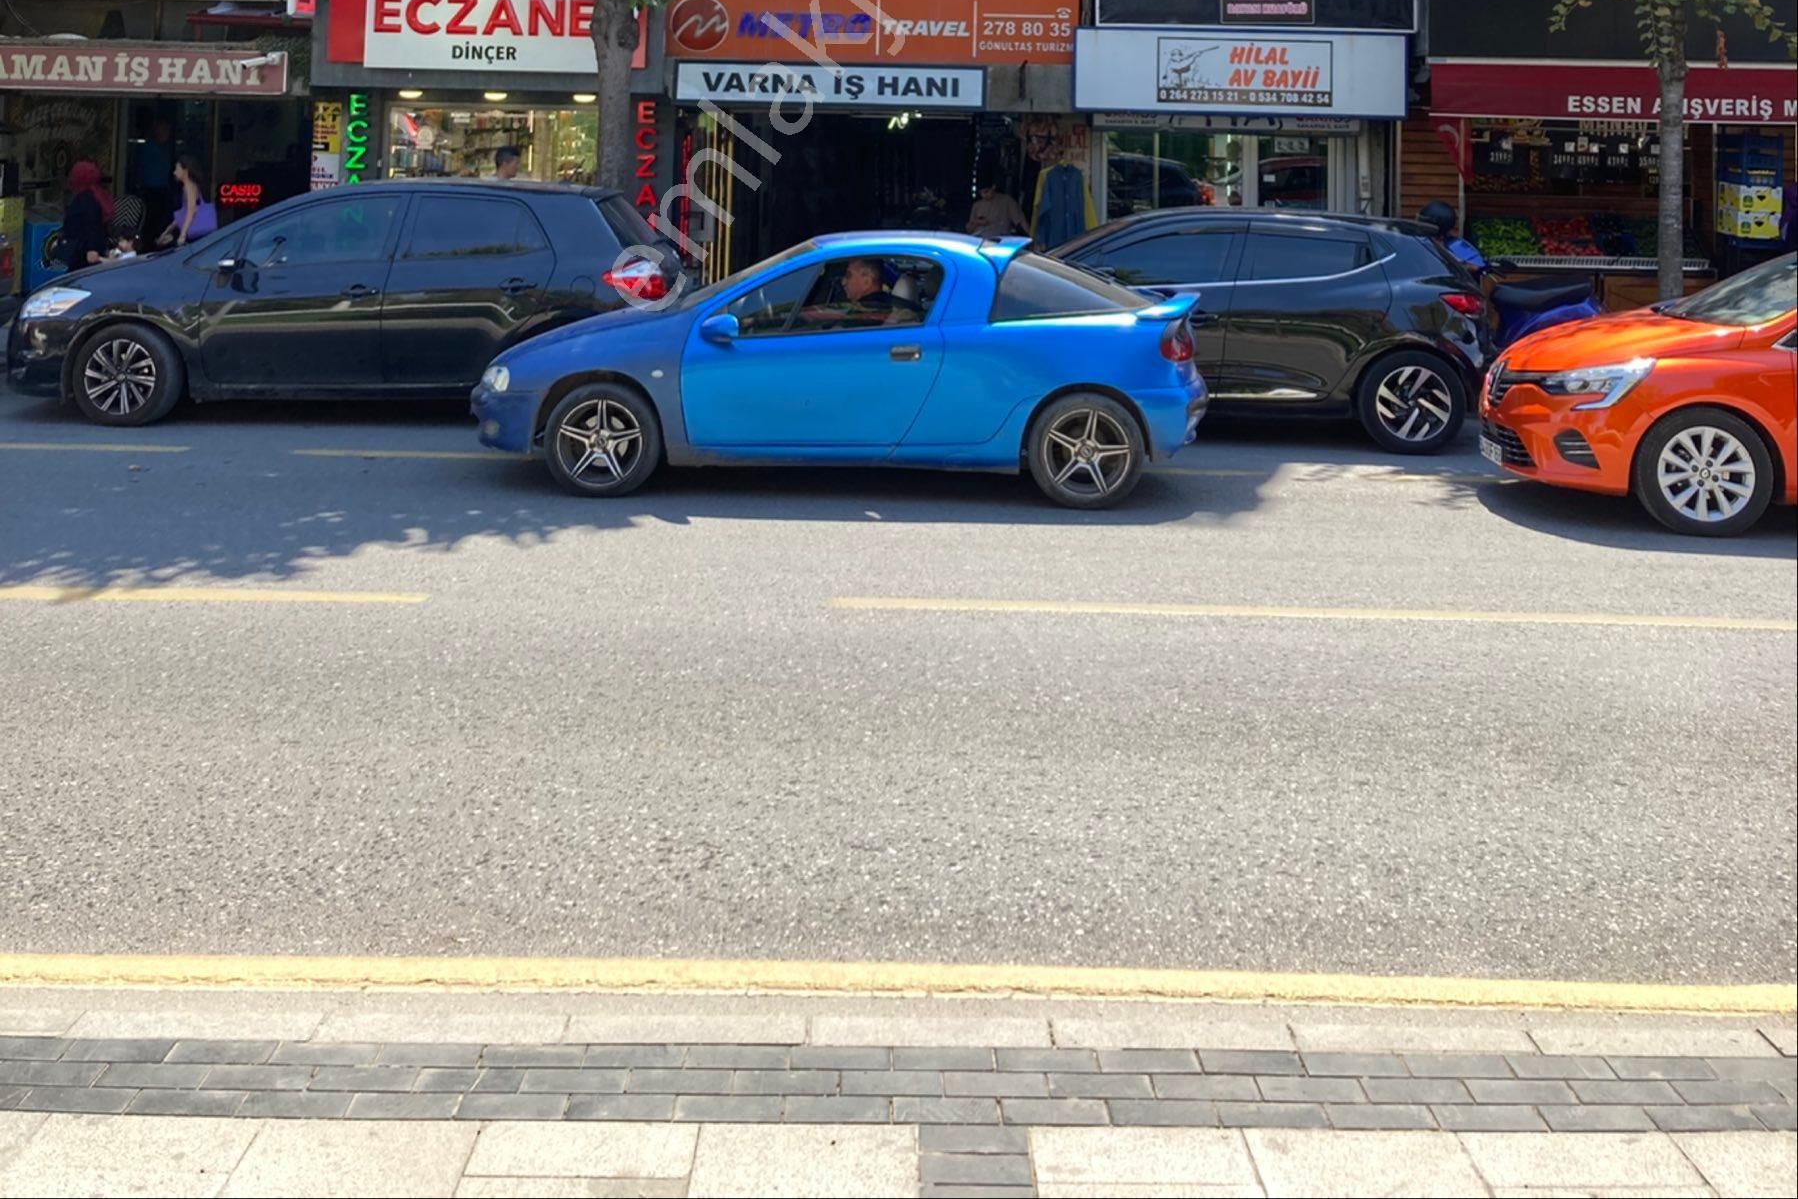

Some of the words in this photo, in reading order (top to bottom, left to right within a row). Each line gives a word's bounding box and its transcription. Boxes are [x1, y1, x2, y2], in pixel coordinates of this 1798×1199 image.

[736, 11, 872, 40] METRO
[882, 19, 971, 38] TRAVEL
[983, 20, 1016, 36] 278
[1021, 22, 1044, 37] 80
[1049, 22, 1072, 38] 35
[452, 41, 518, 65] DİNÇER
[1228, 42, 1290, 66] HİLAL
[113, 52, 150, 87] İŞ
[157, 57, 263, 86] HANI
[1228, 68, 1258, 88] AV
[702, 71, 818, 94] VARNA
[833, 69, 866, 100] İŞ
[877, 75, 960, 98] HANI
[1160, 90, 1167, 100] 0
[1169, 90, 1188, 101] 264
[1190, 91, 1209, 101] 273
[1212, 91, 1224, 101] 15
[1227, 92, 1239, 102] 21
[1249, 92, 1256, 103] 0
[1258, 93, 1277, 103] 534
[1280, 93, 1299, 104] 708
[1301, 94, 1314, 104] 42
[1317, 95, 1330, 105] 54
[1567, 95, 1642, 115] ESSEN
[1652, 95, 1773, 121] AIŞVERİŞ
[220, 183, 262, 197] CASIO
